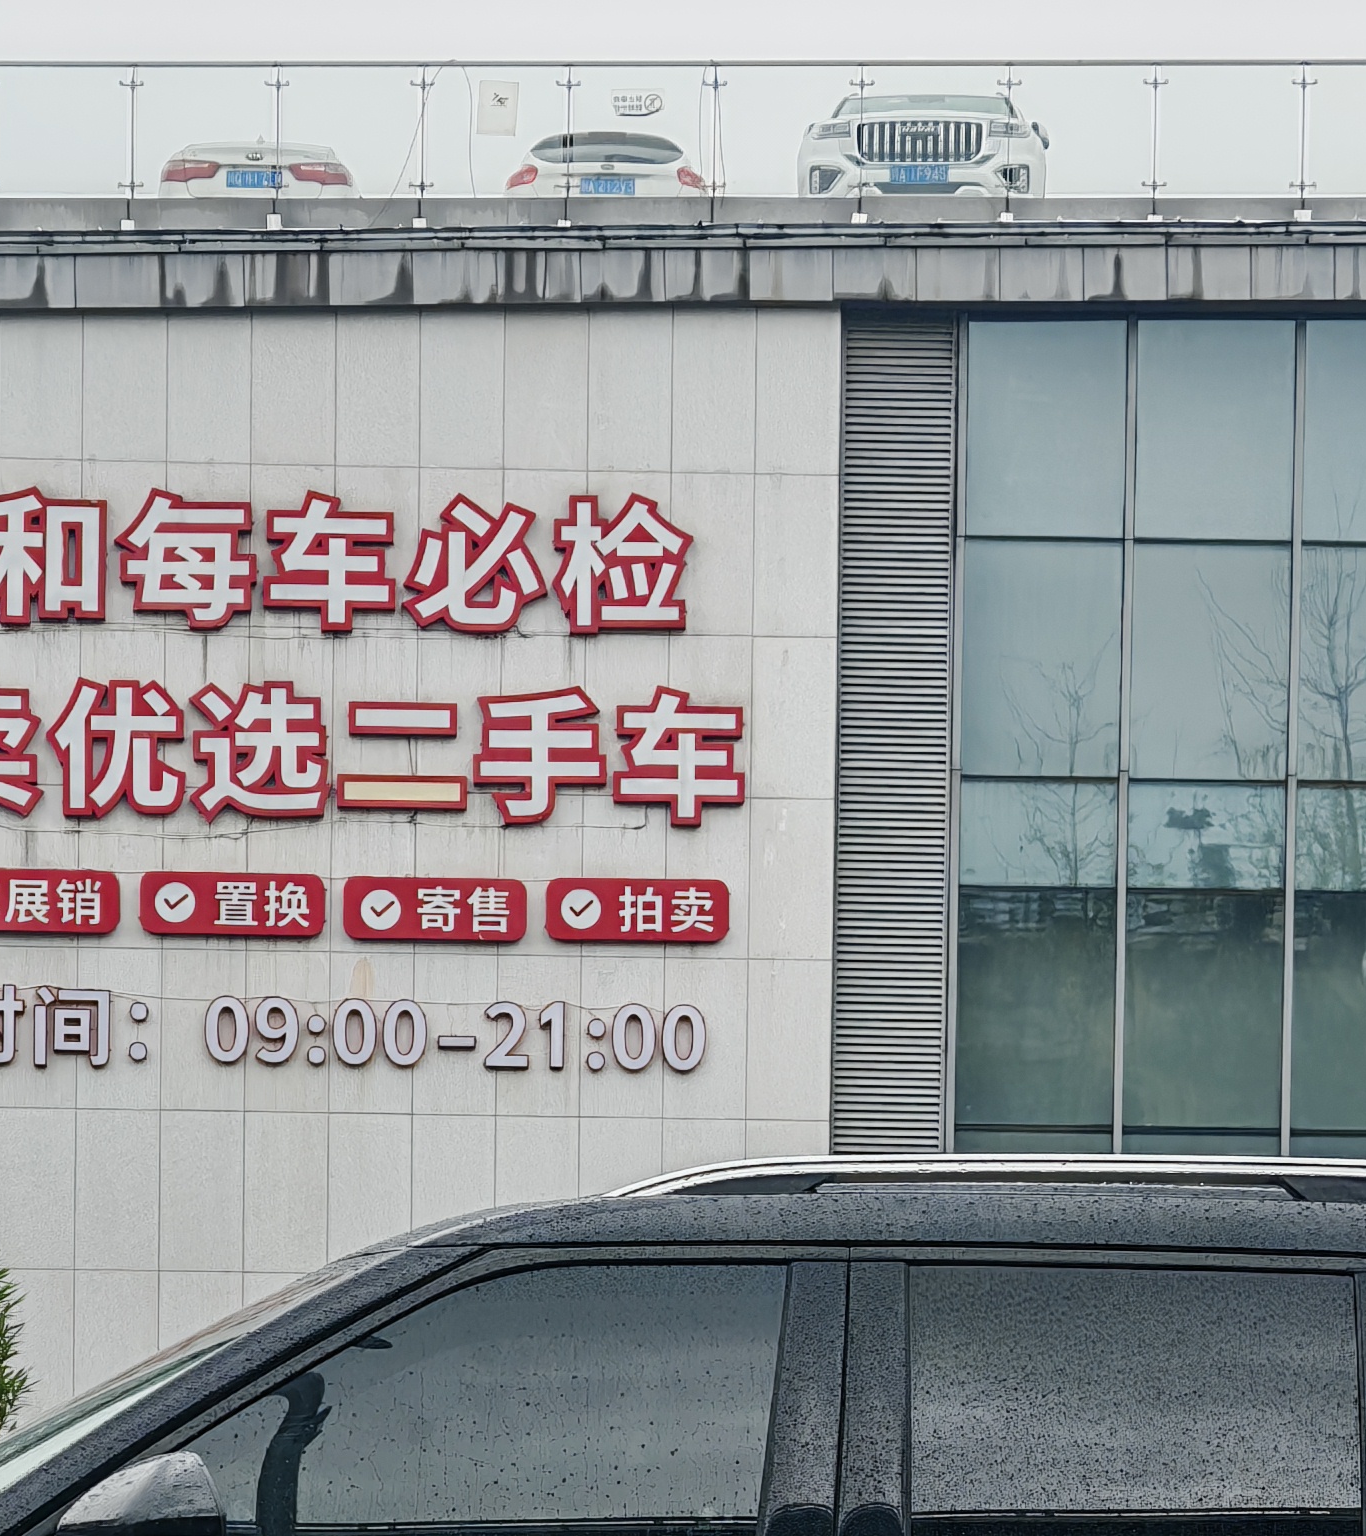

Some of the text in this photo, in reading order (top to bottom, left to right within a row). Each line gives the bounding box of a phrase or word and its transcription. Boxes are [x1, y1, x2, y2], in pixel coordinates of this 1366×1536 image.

[212, 880, 311, 930] 置换
[415, 884, 513, 935] 寄售
[618, 884, 717, 935] 拍卖
[204, 994, 707, 1074] 09:00-21:00
